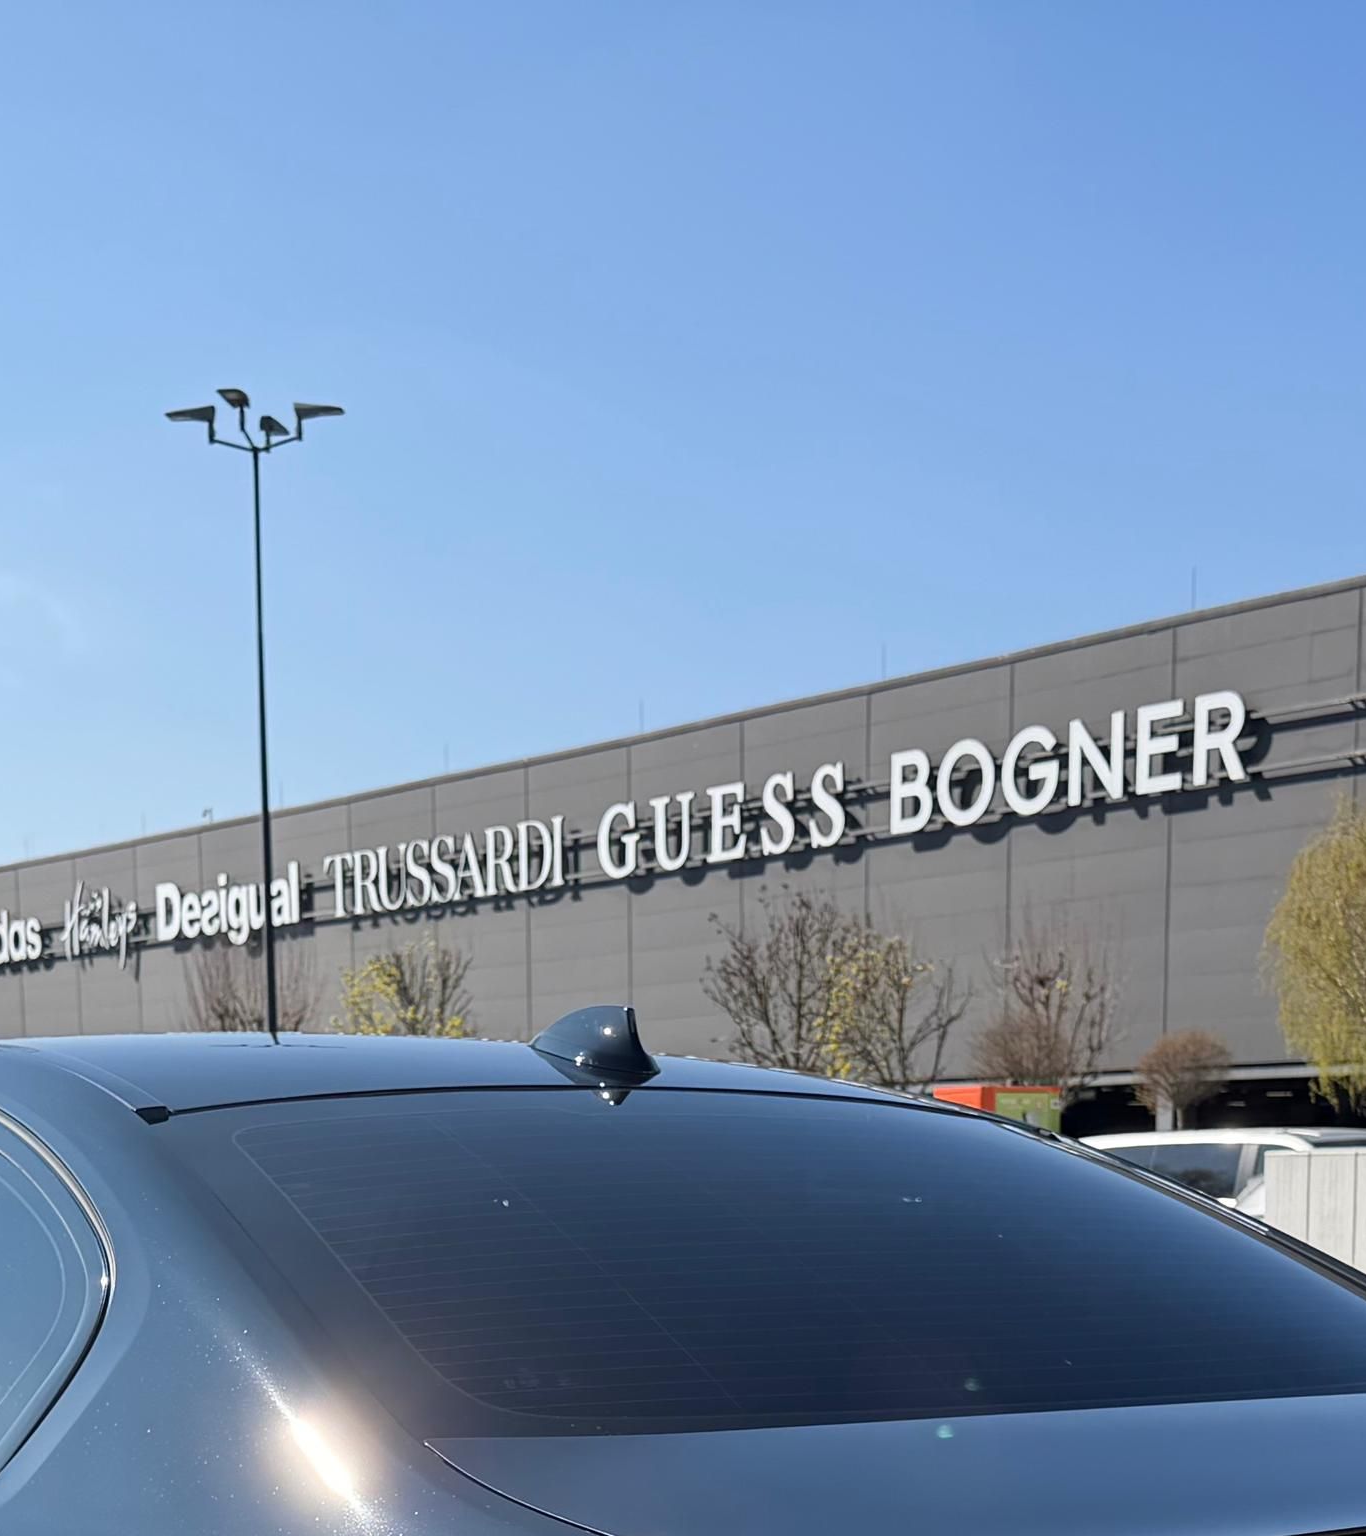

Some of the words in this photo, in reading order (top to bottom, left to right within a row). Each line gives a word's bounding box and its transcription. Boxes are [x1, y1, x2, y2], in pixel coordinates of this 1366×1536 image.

[889, 690, 1248, 836] BOGNER
[323, 815, 566, 917] TRUSSARDI
[597, 763, 847, 880] GUESS
[60, 879, 137, 970] Hamleys
[155, 861, 301, 946] Desigual
